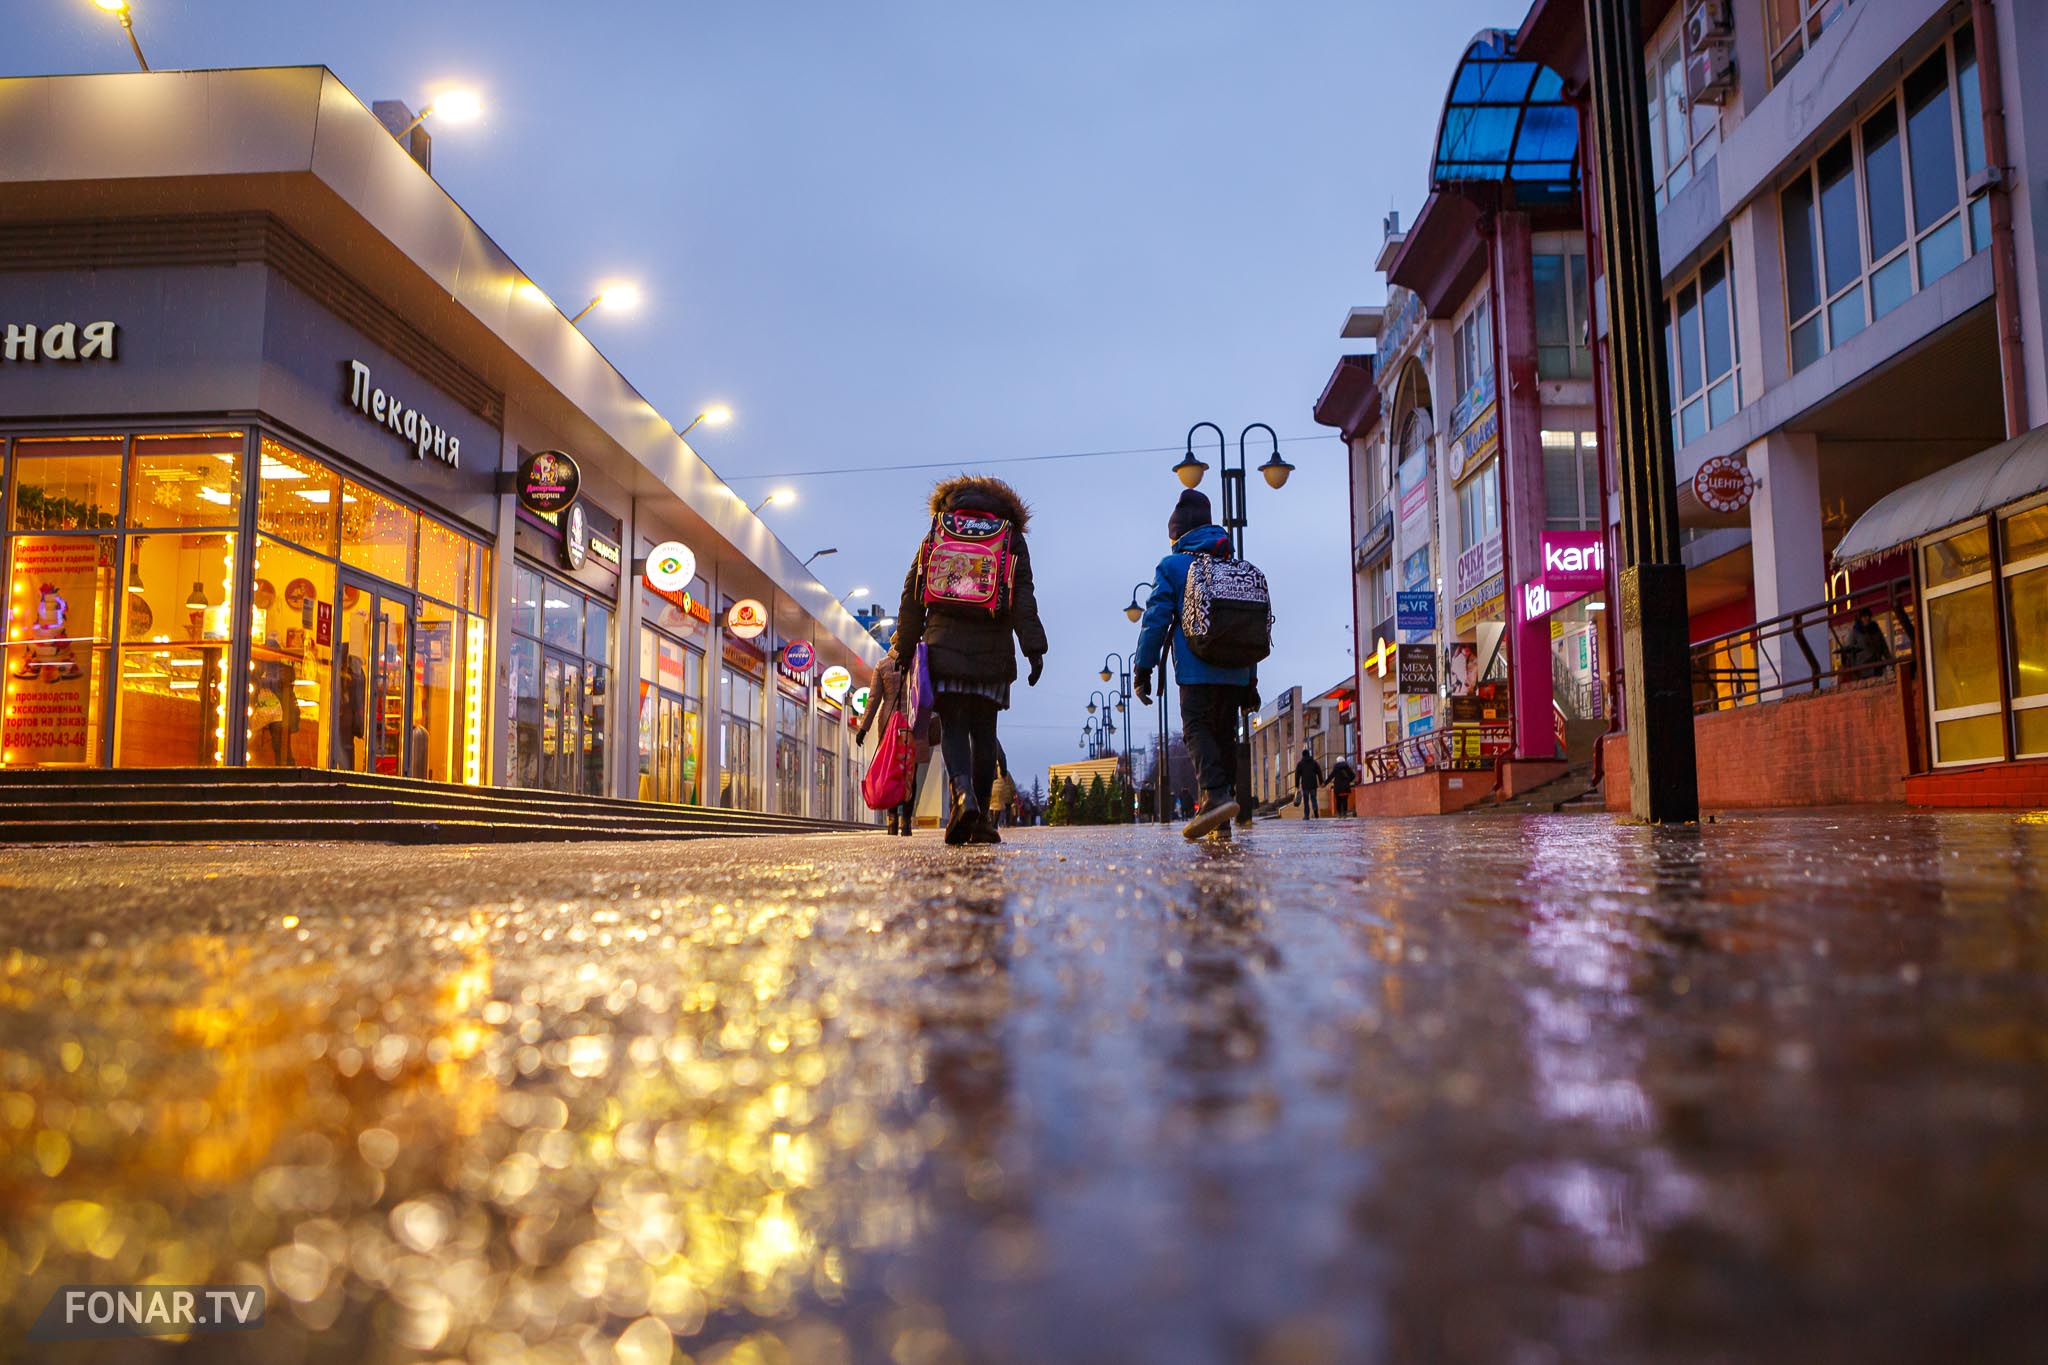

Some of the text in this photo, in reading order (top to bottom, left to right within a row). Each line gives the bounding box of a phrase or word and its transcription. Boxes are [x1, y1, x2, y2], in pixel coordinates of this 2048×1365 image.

[351, 359, 460, 469] Пекарня
[1708, 477, 1744, 489] ЦЕНТР
[1457, 541, 1485, 582] ОЧКИ
[1545, 541, 1600, 571] kari
[1410, 600, 1429, 612] VR
[1402, 663, 1433, 673] МЕХА
[1401, 673, 1435, 682] КОЖА
[15, 692, 80, 703] производство
[12, 705, 82, 714] эксклюзивных
[6, 718, 86, 729] тортов на заказ
[4, 731, 86, 748] 8-800-250-43-46
